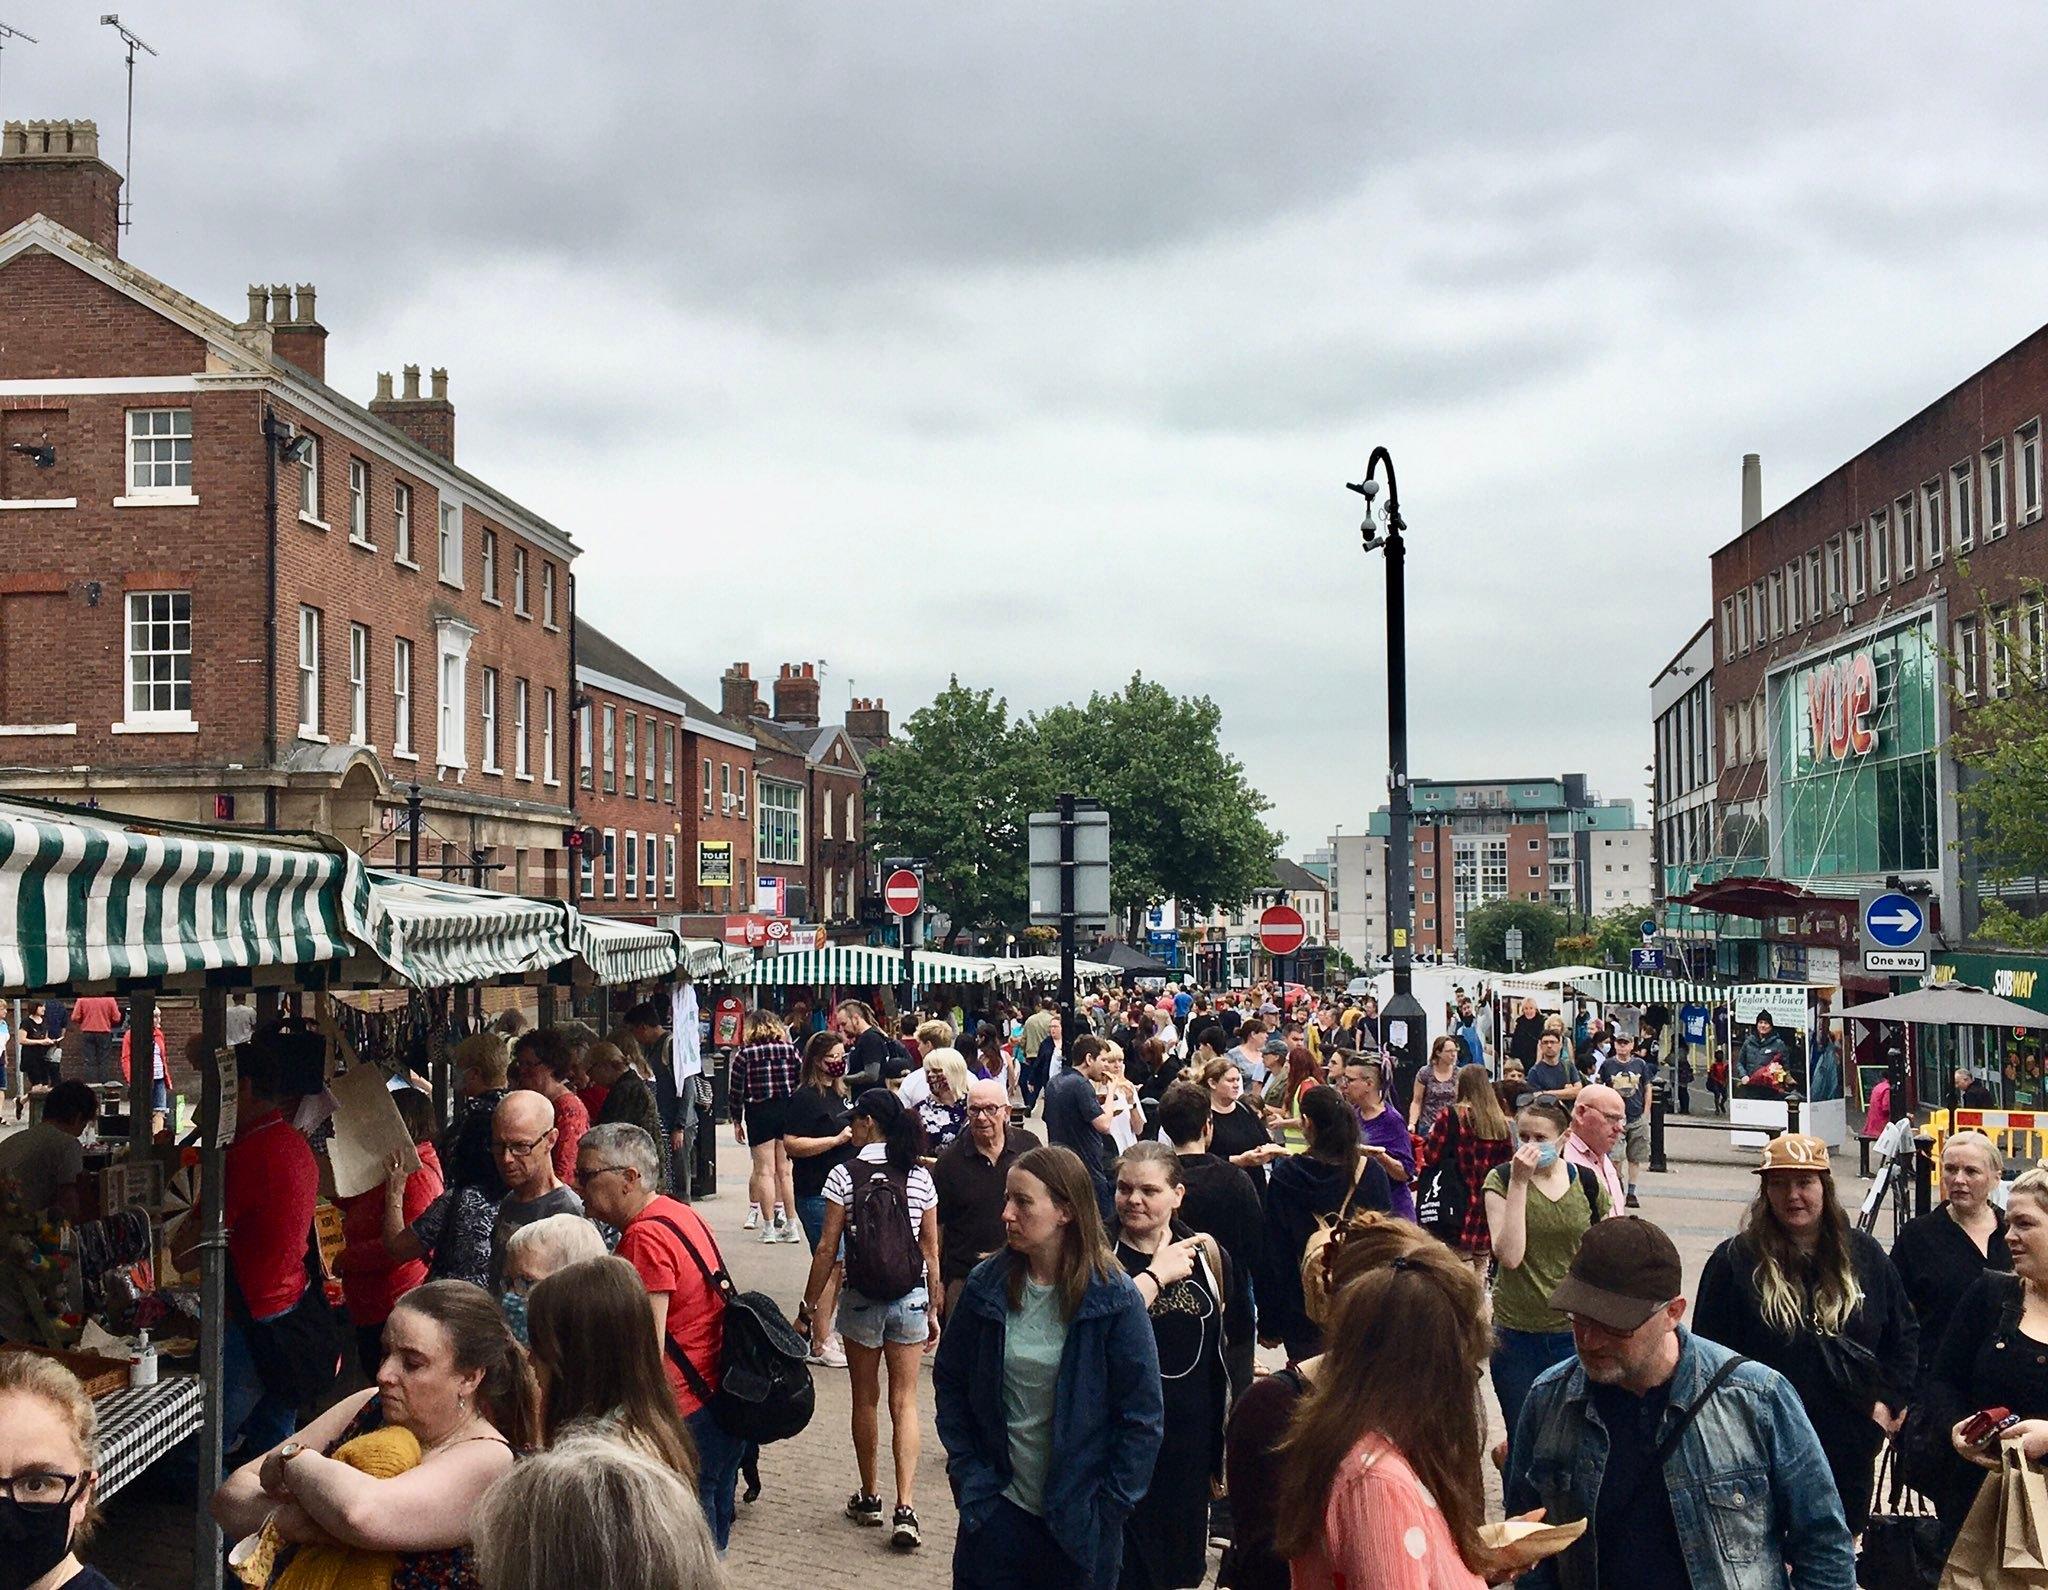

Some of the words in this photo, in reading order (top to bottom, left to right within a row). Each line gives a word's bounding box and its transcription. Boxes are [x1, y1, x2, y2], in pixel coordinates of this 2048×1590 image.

[702, 852, 714, 860] TO
[715, 852, 729, 860] LET
[1871, 956, 1894, 965] One
[1897, 957, 1921, 968] way
[1992, 969, 2037, 999] SUBWAY
[1737, 995, 1770, 1005] Taylor's
